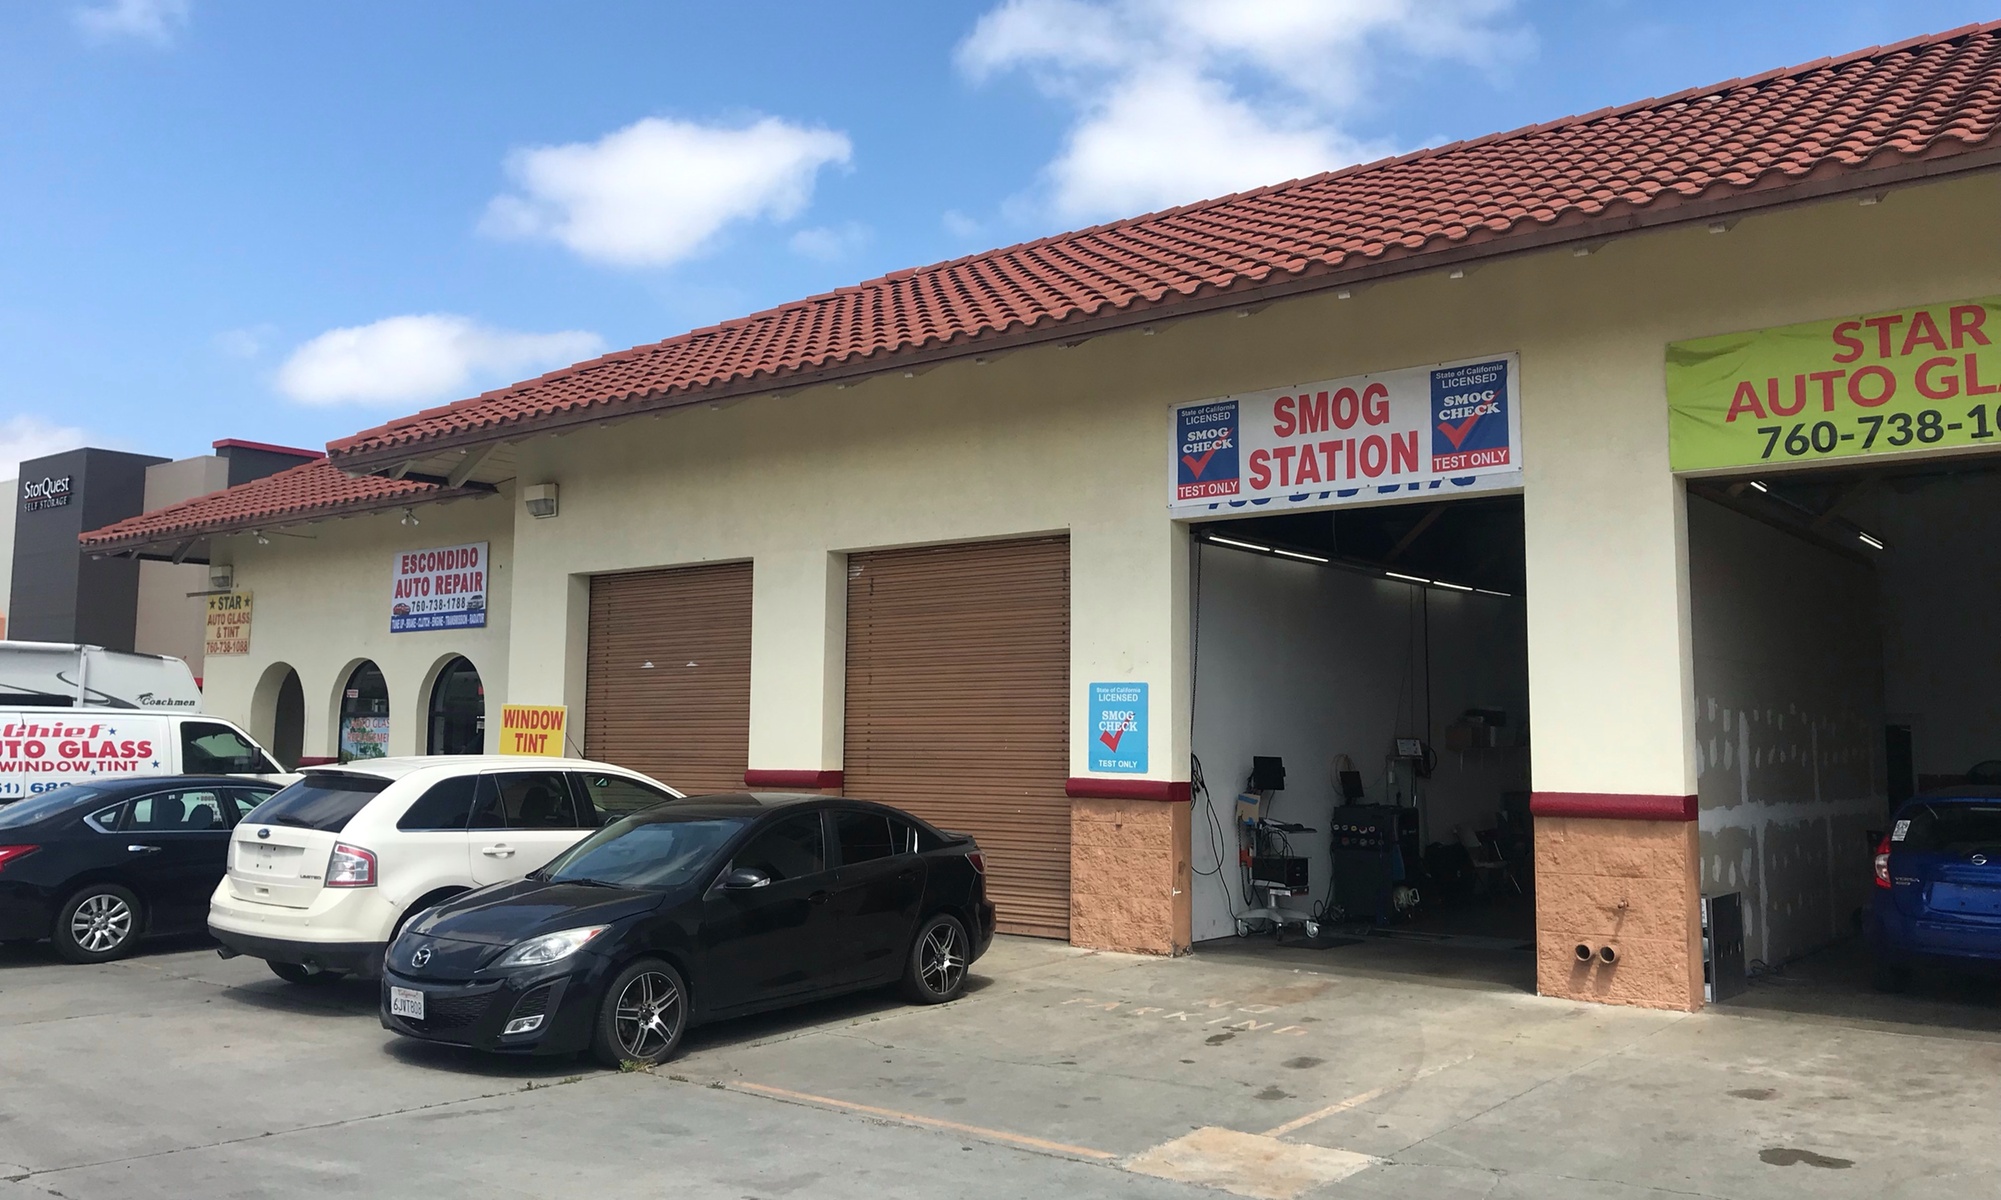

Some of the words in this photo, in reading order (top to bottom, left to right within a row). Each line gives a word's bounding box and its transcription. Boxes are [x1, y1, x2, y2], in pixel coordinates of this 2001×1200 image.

[1832, 304, 1992, 364] STAR
[1466, 364, 1504, 375] California
[1442, 372, 1498, 388] LICENSED
[1725, 365, 1897, 423] AUTO
[1914, 353, 2001, 400] GL
[1444, 390, 1495, 406] SMOG
[1206, 404, 1236, 414] California
[1273, 382, 1390, 438] SMOG
[1438, 402, 1501, 420] CHECK
[1186, 412, 1230, 425] LICENSED
[1187, 427, 1229, 442] SMOG
[1757, 404, 2001, 459] 760-738-1
[1182, 438, 1234, 454] CHECK
[1249, 430, 1418, 490] STATION
[1434, 454, 1467, 470] TEST
[1470, 450, 1507, 466] ONLY
[24, 477, 70, 499] StorQuest
[1179, 485, 1206, 498] TEST
[1208, 480, 1238, 495] ONLY
[24, 501, 38, 512] SELF
[40, 496, 67, 509] STORAGE
[401, 547, 478, 574] ESCONDIDO
[394, 577, 430, 598] AUTO
[435, 571, 483, 596] REPAIR
[218, 596, 242, 610] STAR
[412, 597, 466, 612] 760-738-1788
[207, 613, 226, 626] AUTO
[227, 612, 250, 625] GLASS
[216, 627, 221, 638] &
[223, 626, 240, 638] TINT
[142, 698, 196, 706] Coachmen
[1098, 694, 1138, 702] LICENSED
[350, 718, 371, 728] AUTO
[504, 709, 564, 730] WINDOW
[1102, 710, 1135, 720] SMOG
[3, 722, 107, 738] Chief
[1098, 722, 1138, 732] CHECK
[0, 740, 46, 758] TO
[58, 740, 152, 758] GLASS
[515, 732, 548, 754] TINT
[0, 761, 90, 772] WINDOW
[96, 761, 138, 772] TINT
[1118, 760, 1138, 768] ONLY
[0, 782, 20, 794] 1)
